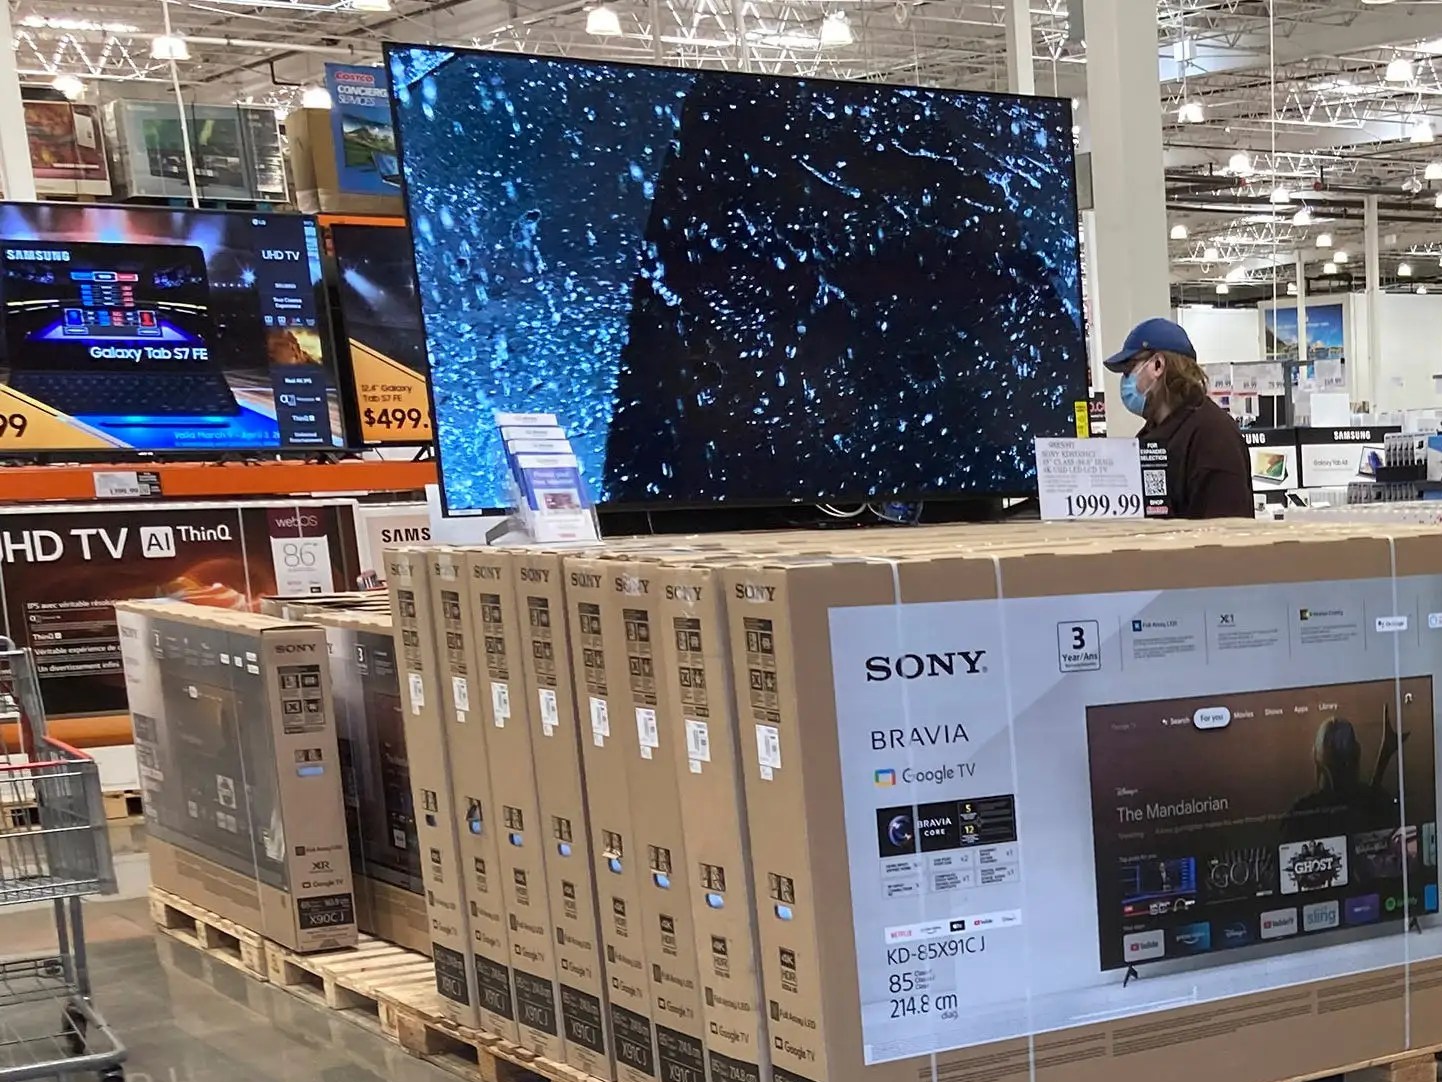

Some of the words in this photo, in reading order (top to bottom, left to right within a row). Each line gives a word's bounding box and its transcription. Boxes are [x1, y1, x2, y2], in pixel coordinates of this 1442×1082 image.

[335, 71, 375, 83] COSTCO
[337, 84, 388, 97] CONCIERG
[6, 249, 71, 262] SAMSUNG
[262, 250, 283, 260] UHD
[285, 251, 300, 261] TV
[90, 346, 142, 362] Galaxy
[144, 347, 171, 359] Tab
[174, 348, 189, 359] S7
[192, 347, 208, 360] FE
[380, 384, 412, 393] Galaxy
[363, 394, 379, 402] Tab
[364, 408, 431, 429] $499.
[197, 431, 226, 440] March
[1242, 432, 1266, 444] UNG
[1334, 431, 1371, 440] SAMSUNG
[1065, 494, 1141, 517] 1999.99
[275, 515, 318, 528] webOS
[381, 527, 432, 543] SAMS
[0, 529, 64, 563] HD
[70, 528, 128, 560] TV
[176, 524, 232, 542] ThinQ
[473, 565, 501, 580] SONY
[521, 568, 549, 583] SONY
[571, 573, 602, 588] SONY
[615, 577, 649, 594] SONY
[665, 586, 702, 601] SONY
[736, 583, 776, 602] SONY
[1072, 626, 1086, 649] 3
[274, 643, 317, 655] SONY
[1062, 652, 1098, 663] Year/Ans
[865, 650, 982, 682] SONY
[1170, 716, 1190, 726] Search
[1200, 714, 1210, 722] For
[1212, 714, 1224, 723] you
[1234, 710, 1254, 719] Movies
[1265, 708, 1284, 716] Shows
[1294, 705, 1309, 714] Apps
[1319, 702, 1338, 712] Library
[871, 723, 969, 750] BRAVIA
[902, 764, 954, 784] Google
[958, 763, 976, 778] TV
[965, 804, 971, 813] 5
[1117, 806, 1143, 823] The
[1146, 796, 1229, 820] Mandalorian
[917, 817, 952, 829] BRAVIA
[924, 828, 946, 837] CORE
[1294, 857, 1334, 875] GHOST
[312, 879, 334, 889] Google
[334, 878, 344, 886] TV
[1307, 907, 1336, 925] sling
[887, 936, 985, 965] KD-85X91CJ
[889, 972, 914, 993] 85
[667, 1000, 685, 1018] Google
[890, 994, 930, 1018] 214.8
[935, 993, 958, 1011] cm
[941, 1010, 959, 1020] diag
[719, 1024, 739, 1043] Google
[739, 1031, 749, 1043] TV
[784, 1040, 807, 1060] Google
[806, 1049, 815, 1061] TV
